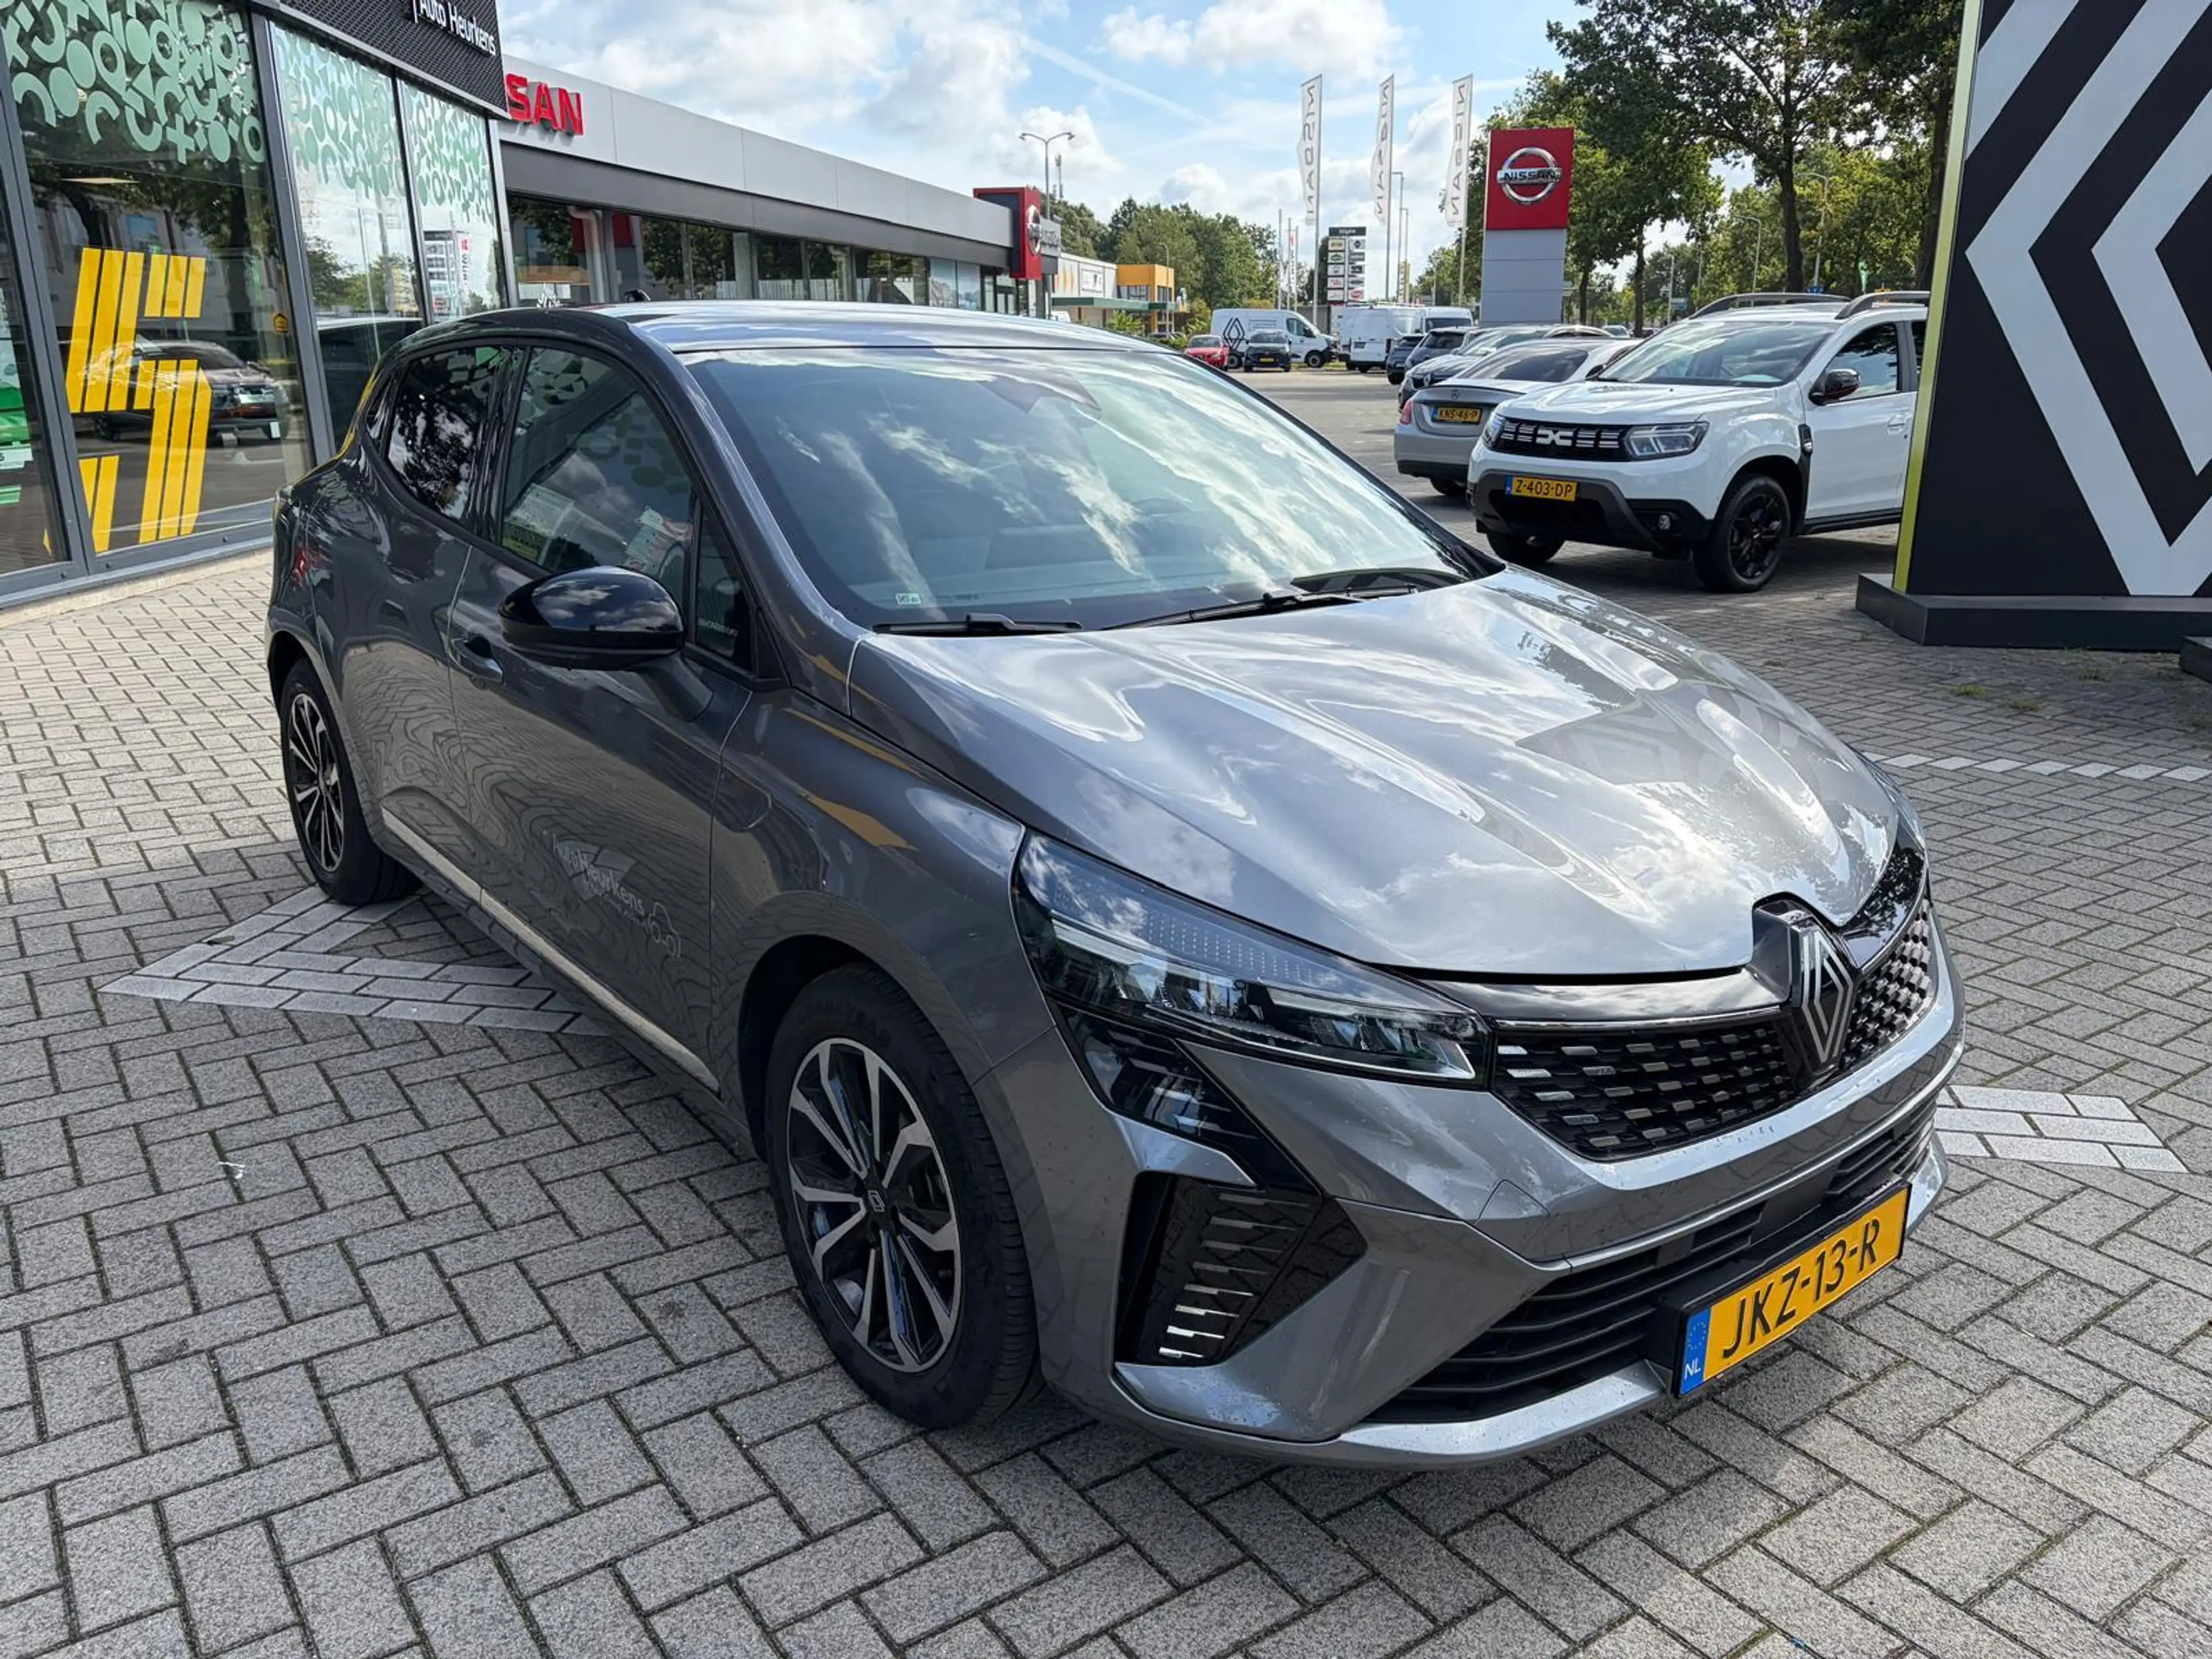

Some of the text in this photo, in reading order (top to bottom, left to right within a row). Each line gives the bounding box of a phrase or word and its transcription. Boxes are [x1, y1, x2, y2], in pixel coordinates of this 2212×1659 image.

[1503, 169, 1556, 181] NISSAN
[1515, 479, 1573, 498] Z-403-DP
[1683, 1217, 1880, 1380] NL JKZ-13-R
